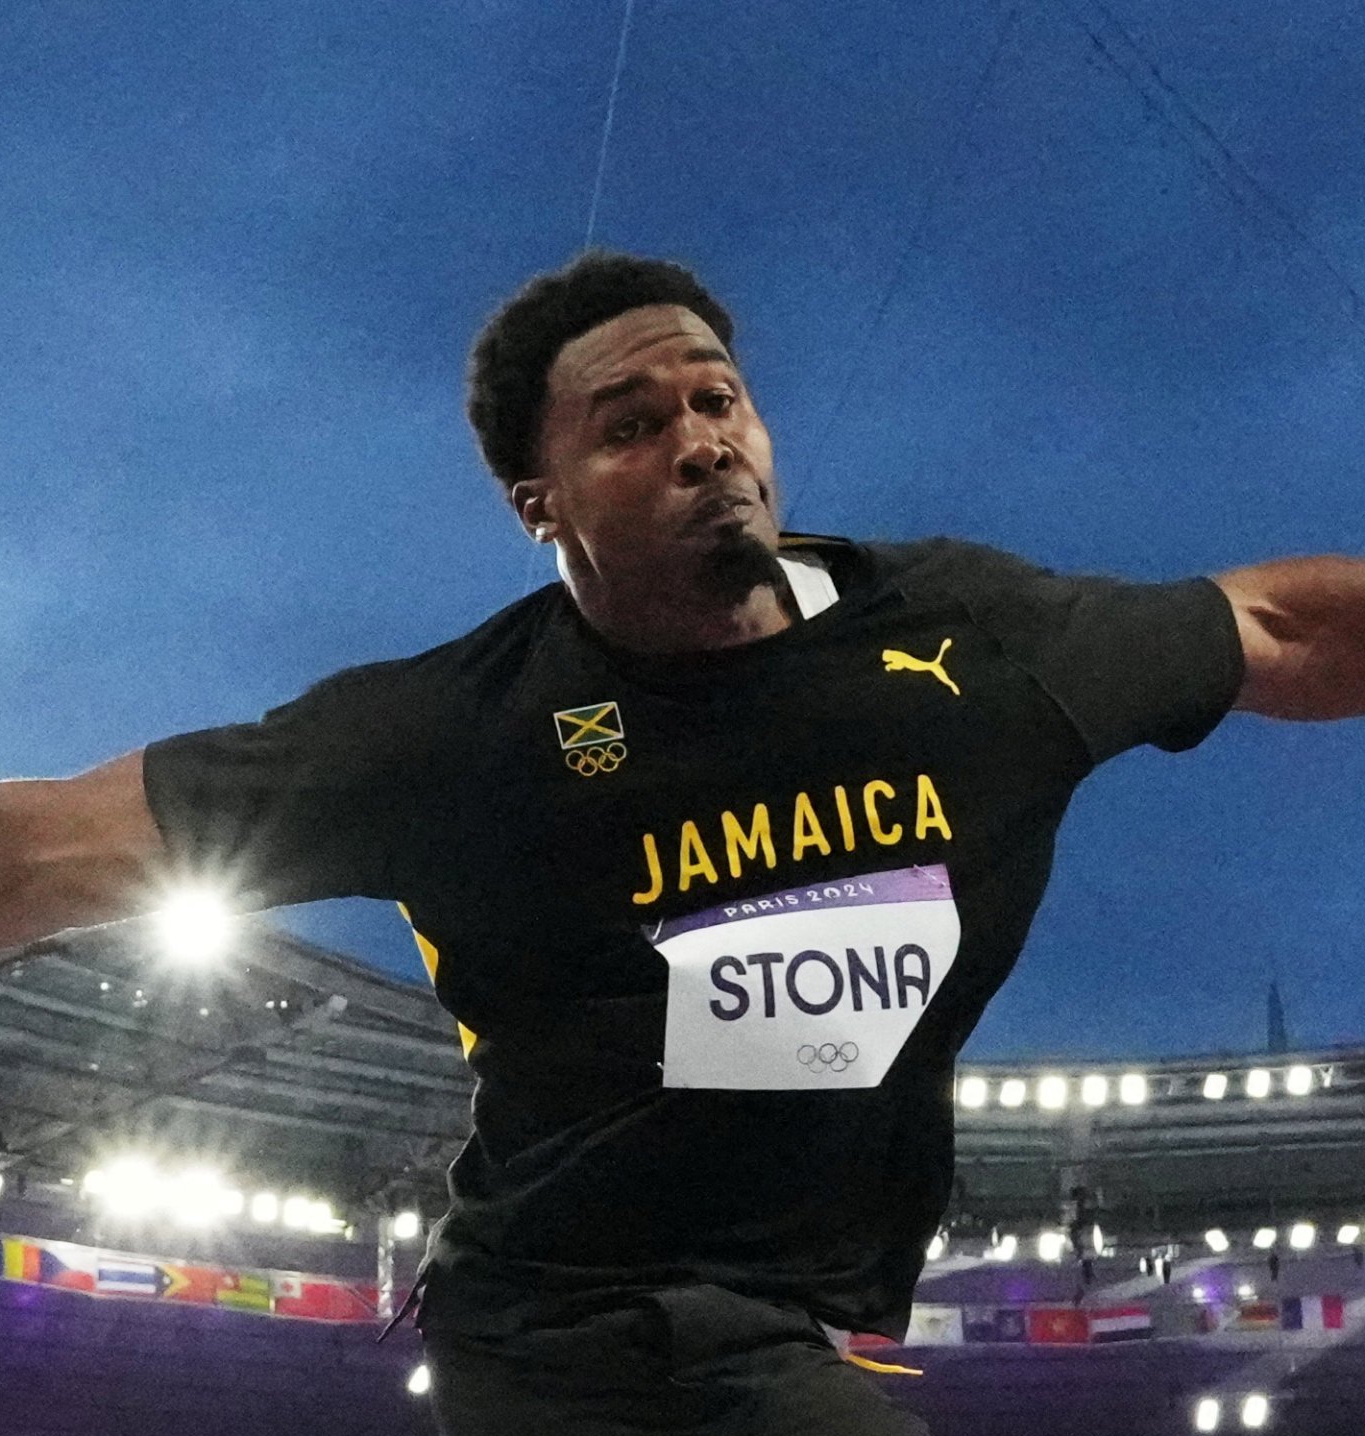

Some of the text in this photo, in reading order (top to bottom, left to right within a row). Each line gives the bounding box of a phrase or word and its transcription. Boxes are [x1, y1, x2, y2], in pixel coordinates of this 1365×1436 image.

[632, 774, 952, 904] JAMAICA
[723, 883, 874, 918] PARIS 2024
[709, 943, 931, 1021] STONA
